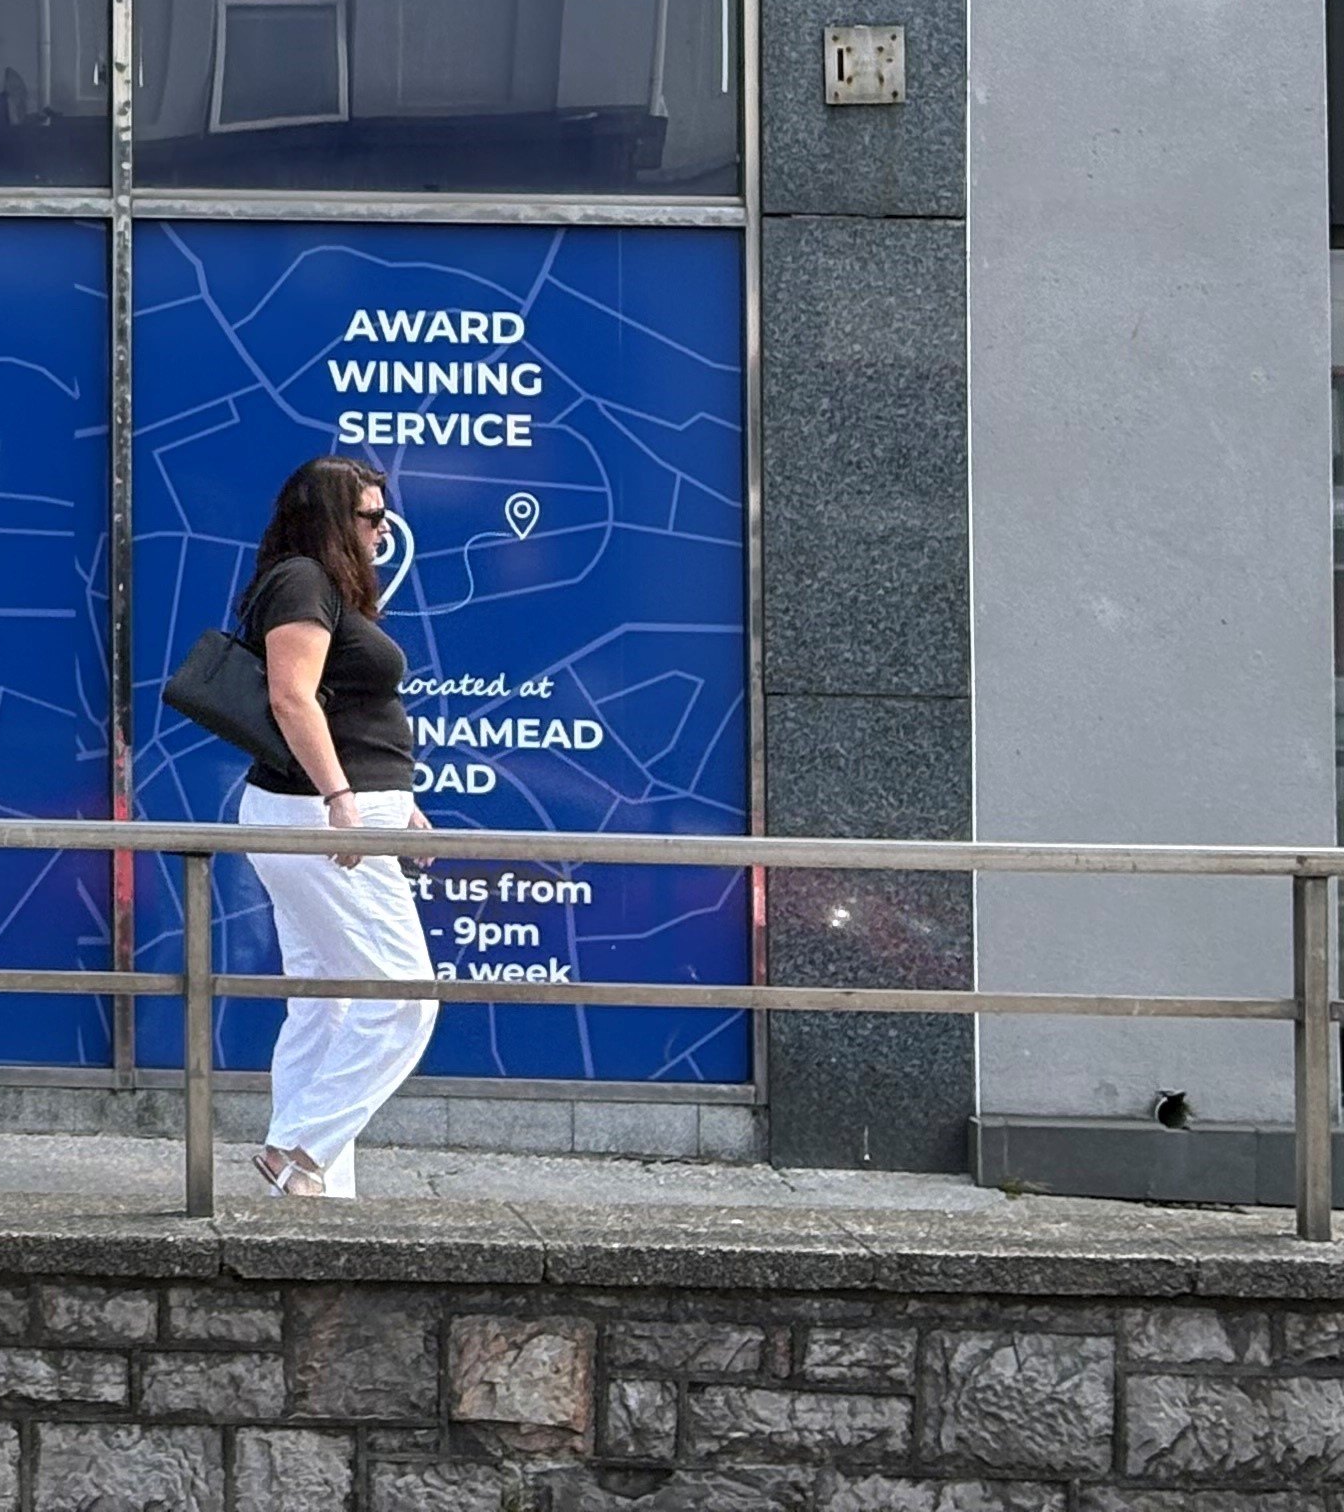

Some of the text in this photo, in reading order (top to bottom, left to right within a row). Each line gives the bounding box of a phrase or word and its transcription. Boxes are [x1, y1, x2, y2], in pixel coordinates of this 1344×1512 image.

[344, 309, 524, 344] AWARD
[328, 360, 542, 395] WINNING
[338, 411, 532, 446] SERVICE
[519, 675, 554, 699] at
[407, 716, 603, 749] NAMEAD
[412, 762, 496, 795] OAD
[445, 877, 489, 902] us
[498, 873, 592, 904] from
[430, 916, 539, 952] - 9pm
[437, 957, 572, 983] a week
